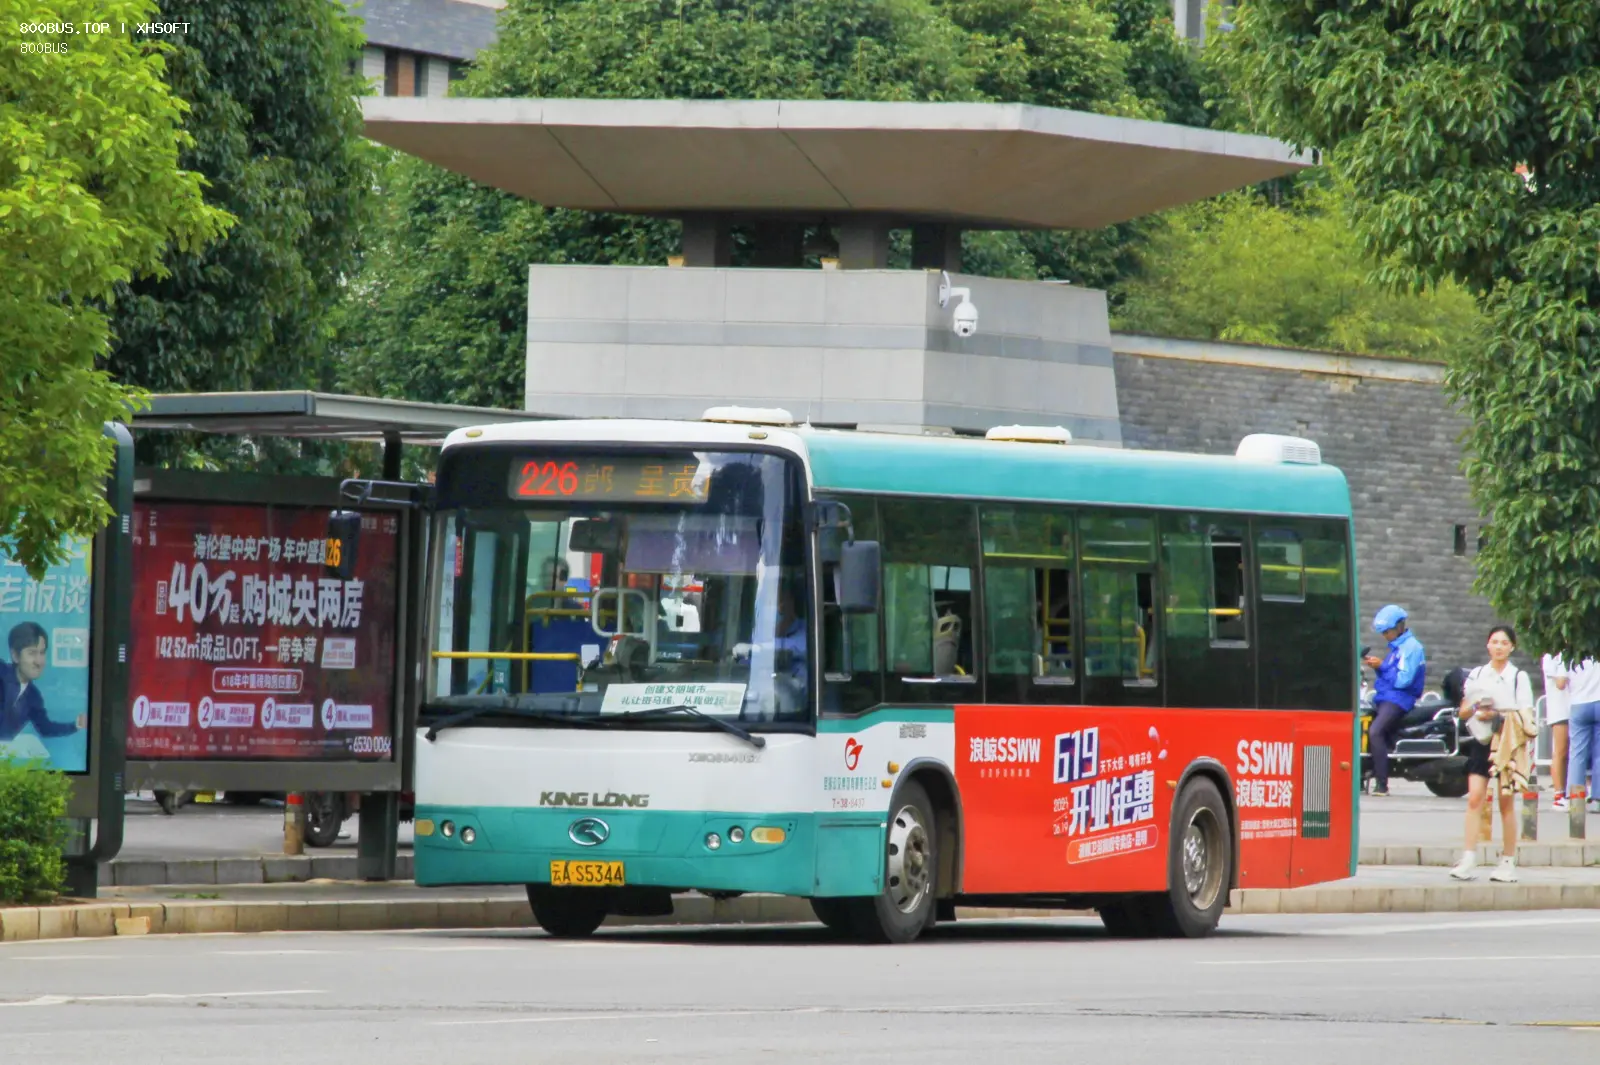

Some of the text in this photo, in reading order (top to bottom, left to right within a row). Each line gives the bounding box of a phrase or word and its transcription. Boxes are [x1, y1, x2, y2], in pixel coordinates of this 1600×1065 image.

[517, 461, 579, 496] 226
[635, 465, 710, 497] 呈贡
[193, 533, 280, 562] 海伦堡中央广场
[0, 573, 89, 613] 老板谈
[241, 573, 365, 628] 购城央两房
[644, 685, 706, 694] 创建文明城市
[138, 700, 145, 721] 1
[201, 702, 210, 722] 2
[263, 703, 273, 722] 3
[325, 704, 334, 723] 4
[969, 737, 1041, 763] 浪鲸SSWW
[1053, 727, 1099, 784] 619
[1236, 739, 1294, 776] SSWW
[540, 791, 650, 807] KING LONG
[1067, 769, 1155, 836] 开业钜惠
[1236, 779, 1294, 808] 浪鲸卫浴
